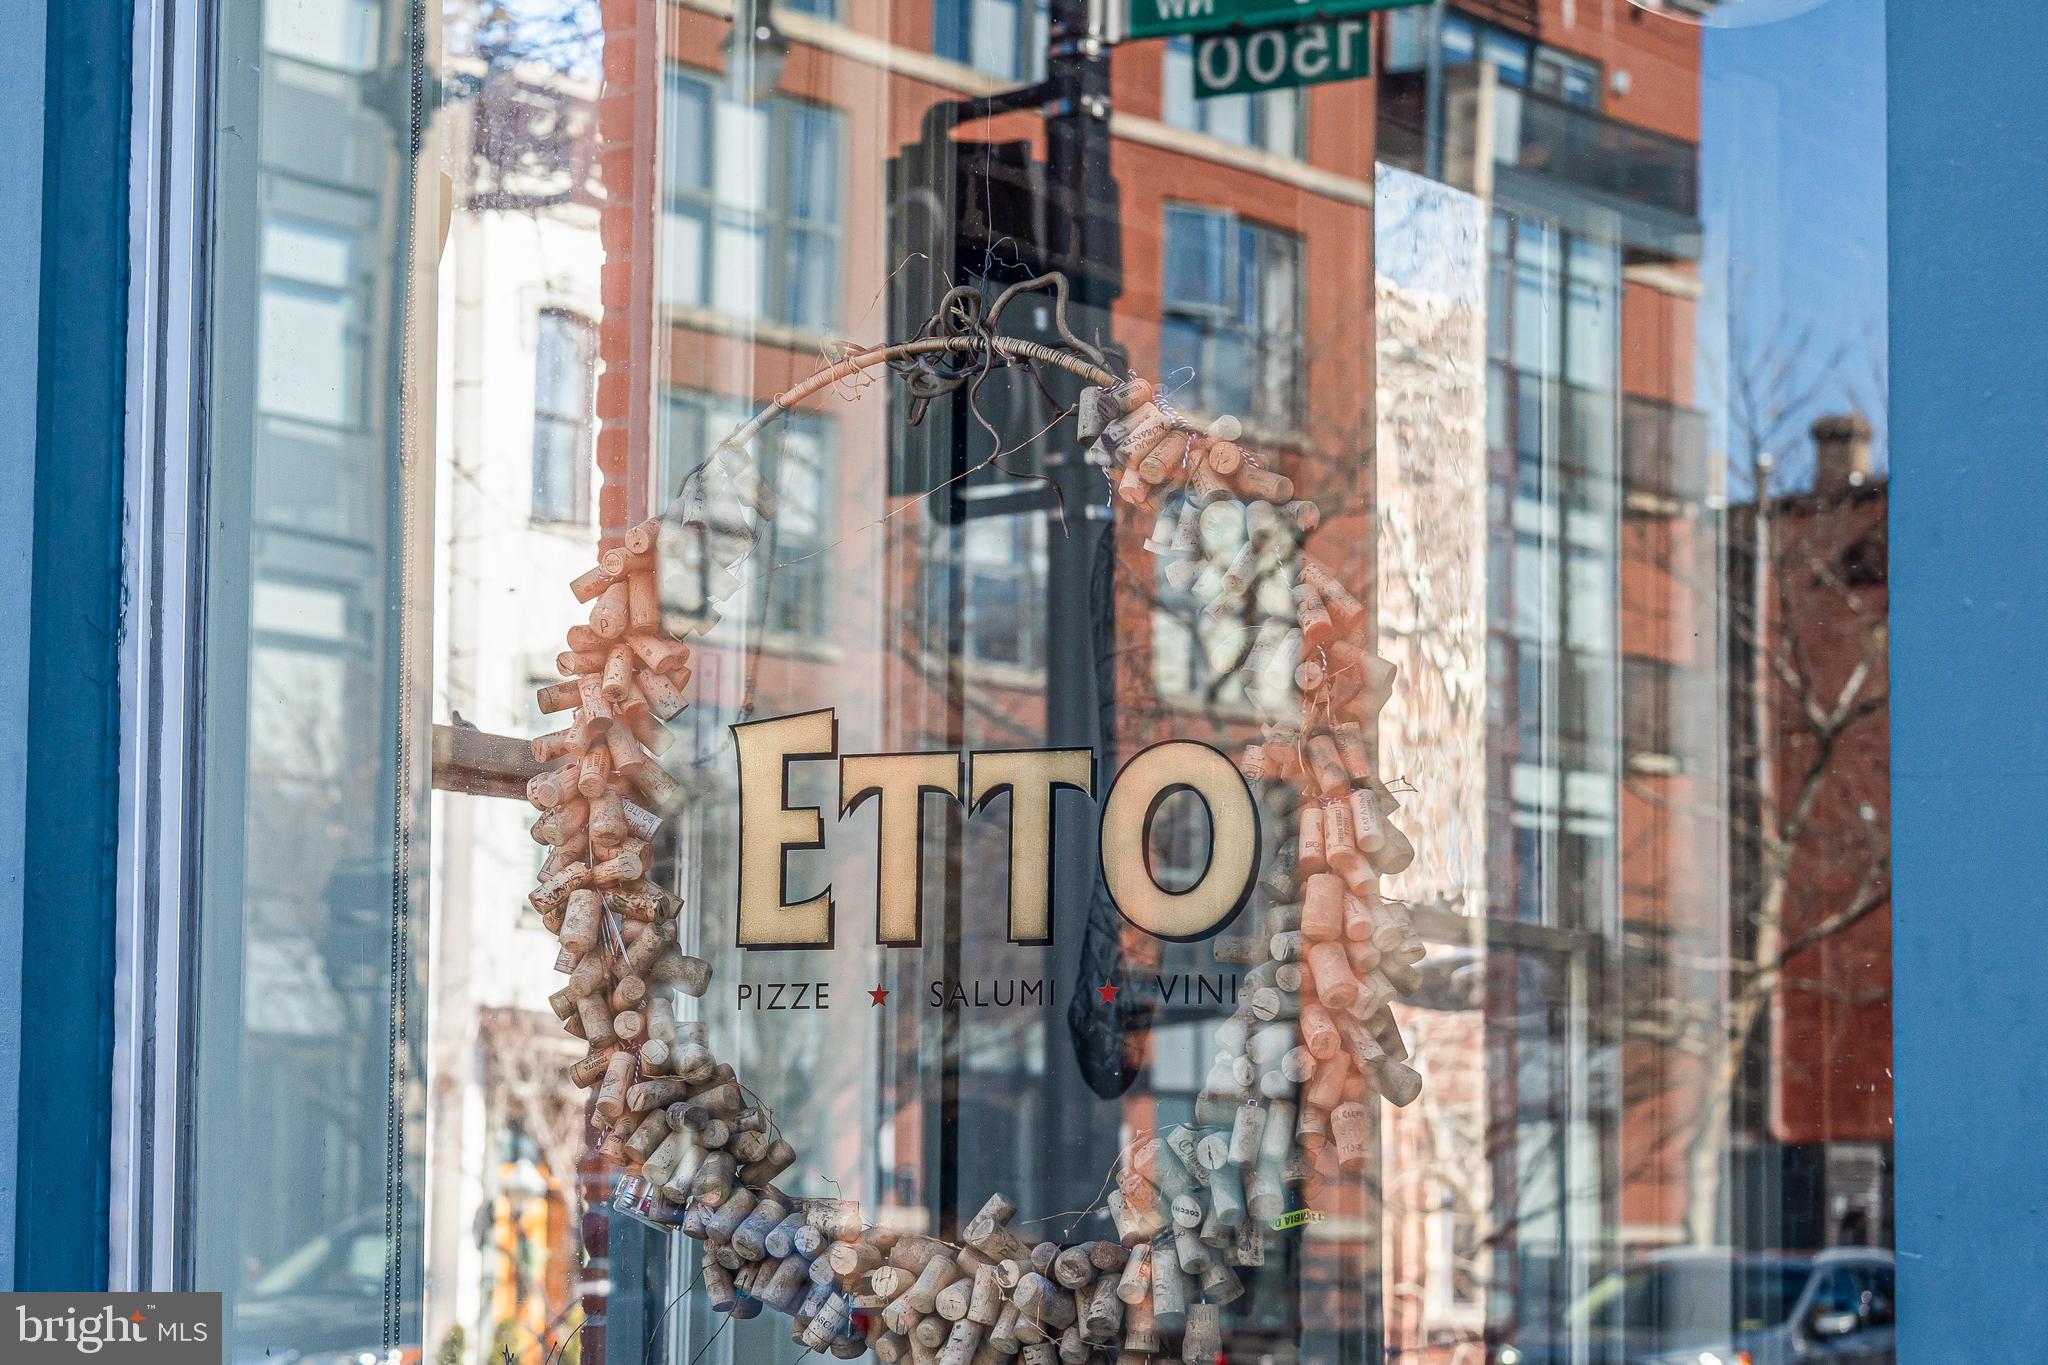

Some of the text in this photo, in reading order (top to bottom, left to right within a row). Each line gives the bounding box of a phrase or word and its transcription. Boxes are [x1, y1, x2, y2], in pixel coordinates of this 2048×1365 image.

[737, 973, 1237, 1011] PIZZE SALUMI VINI
